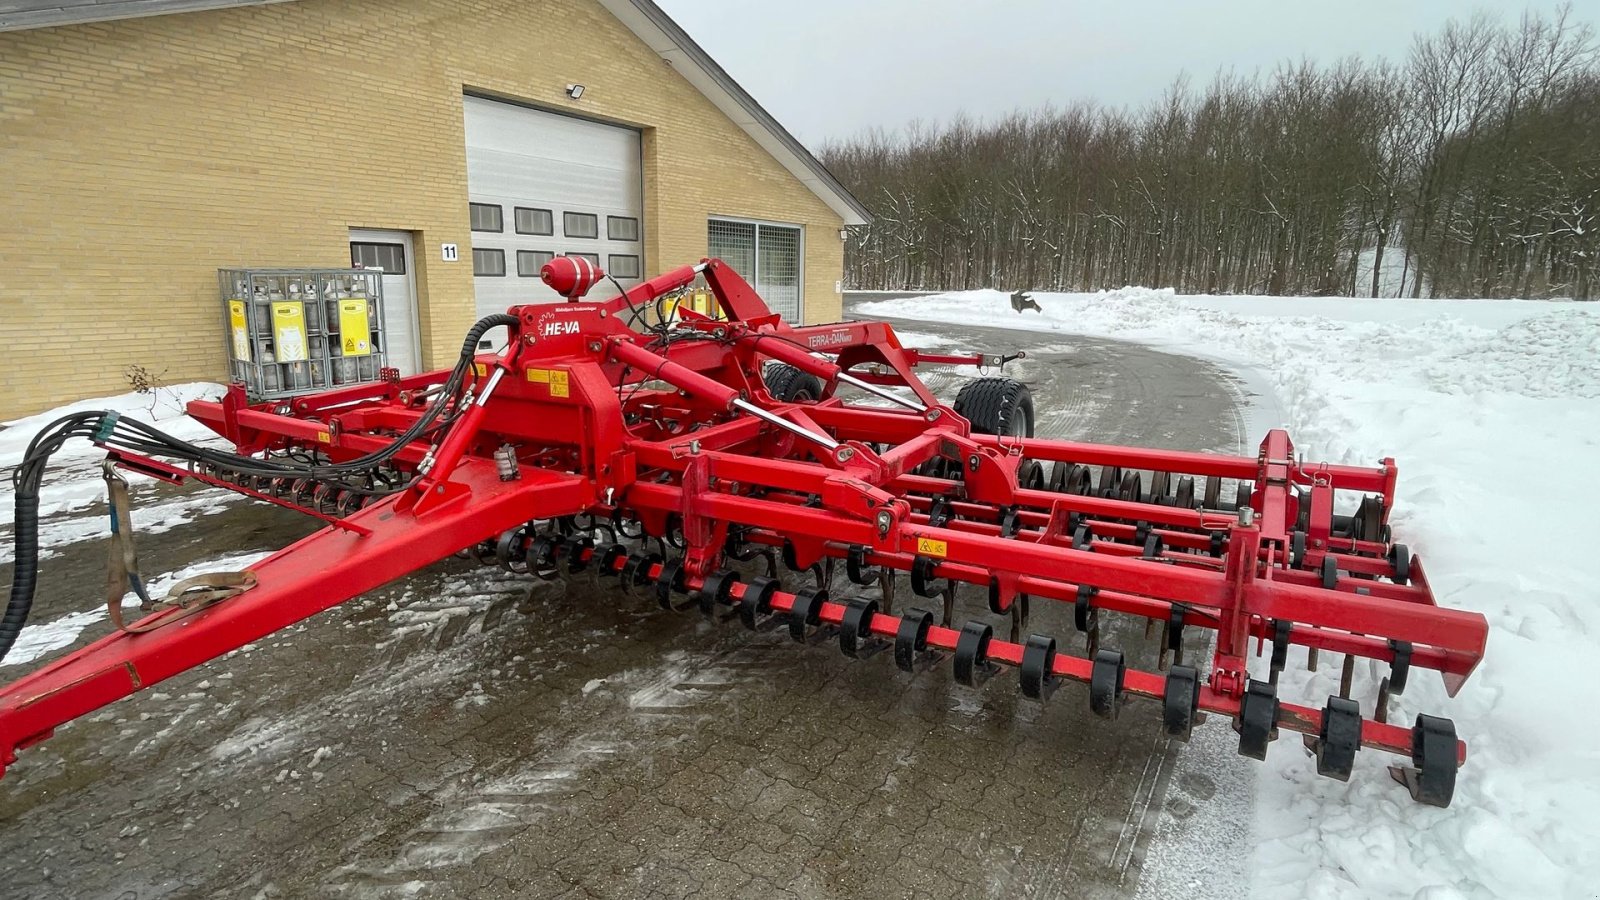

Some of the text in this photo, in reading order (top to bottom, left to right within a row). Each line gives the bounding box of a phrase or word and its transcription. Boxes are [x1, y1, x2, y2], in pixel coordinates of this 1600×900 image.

[444, 246, 456, 259] 11
[545, 321, 580, 336] HE-VA
[808, 332, 845, 348] TERRA-DAN
